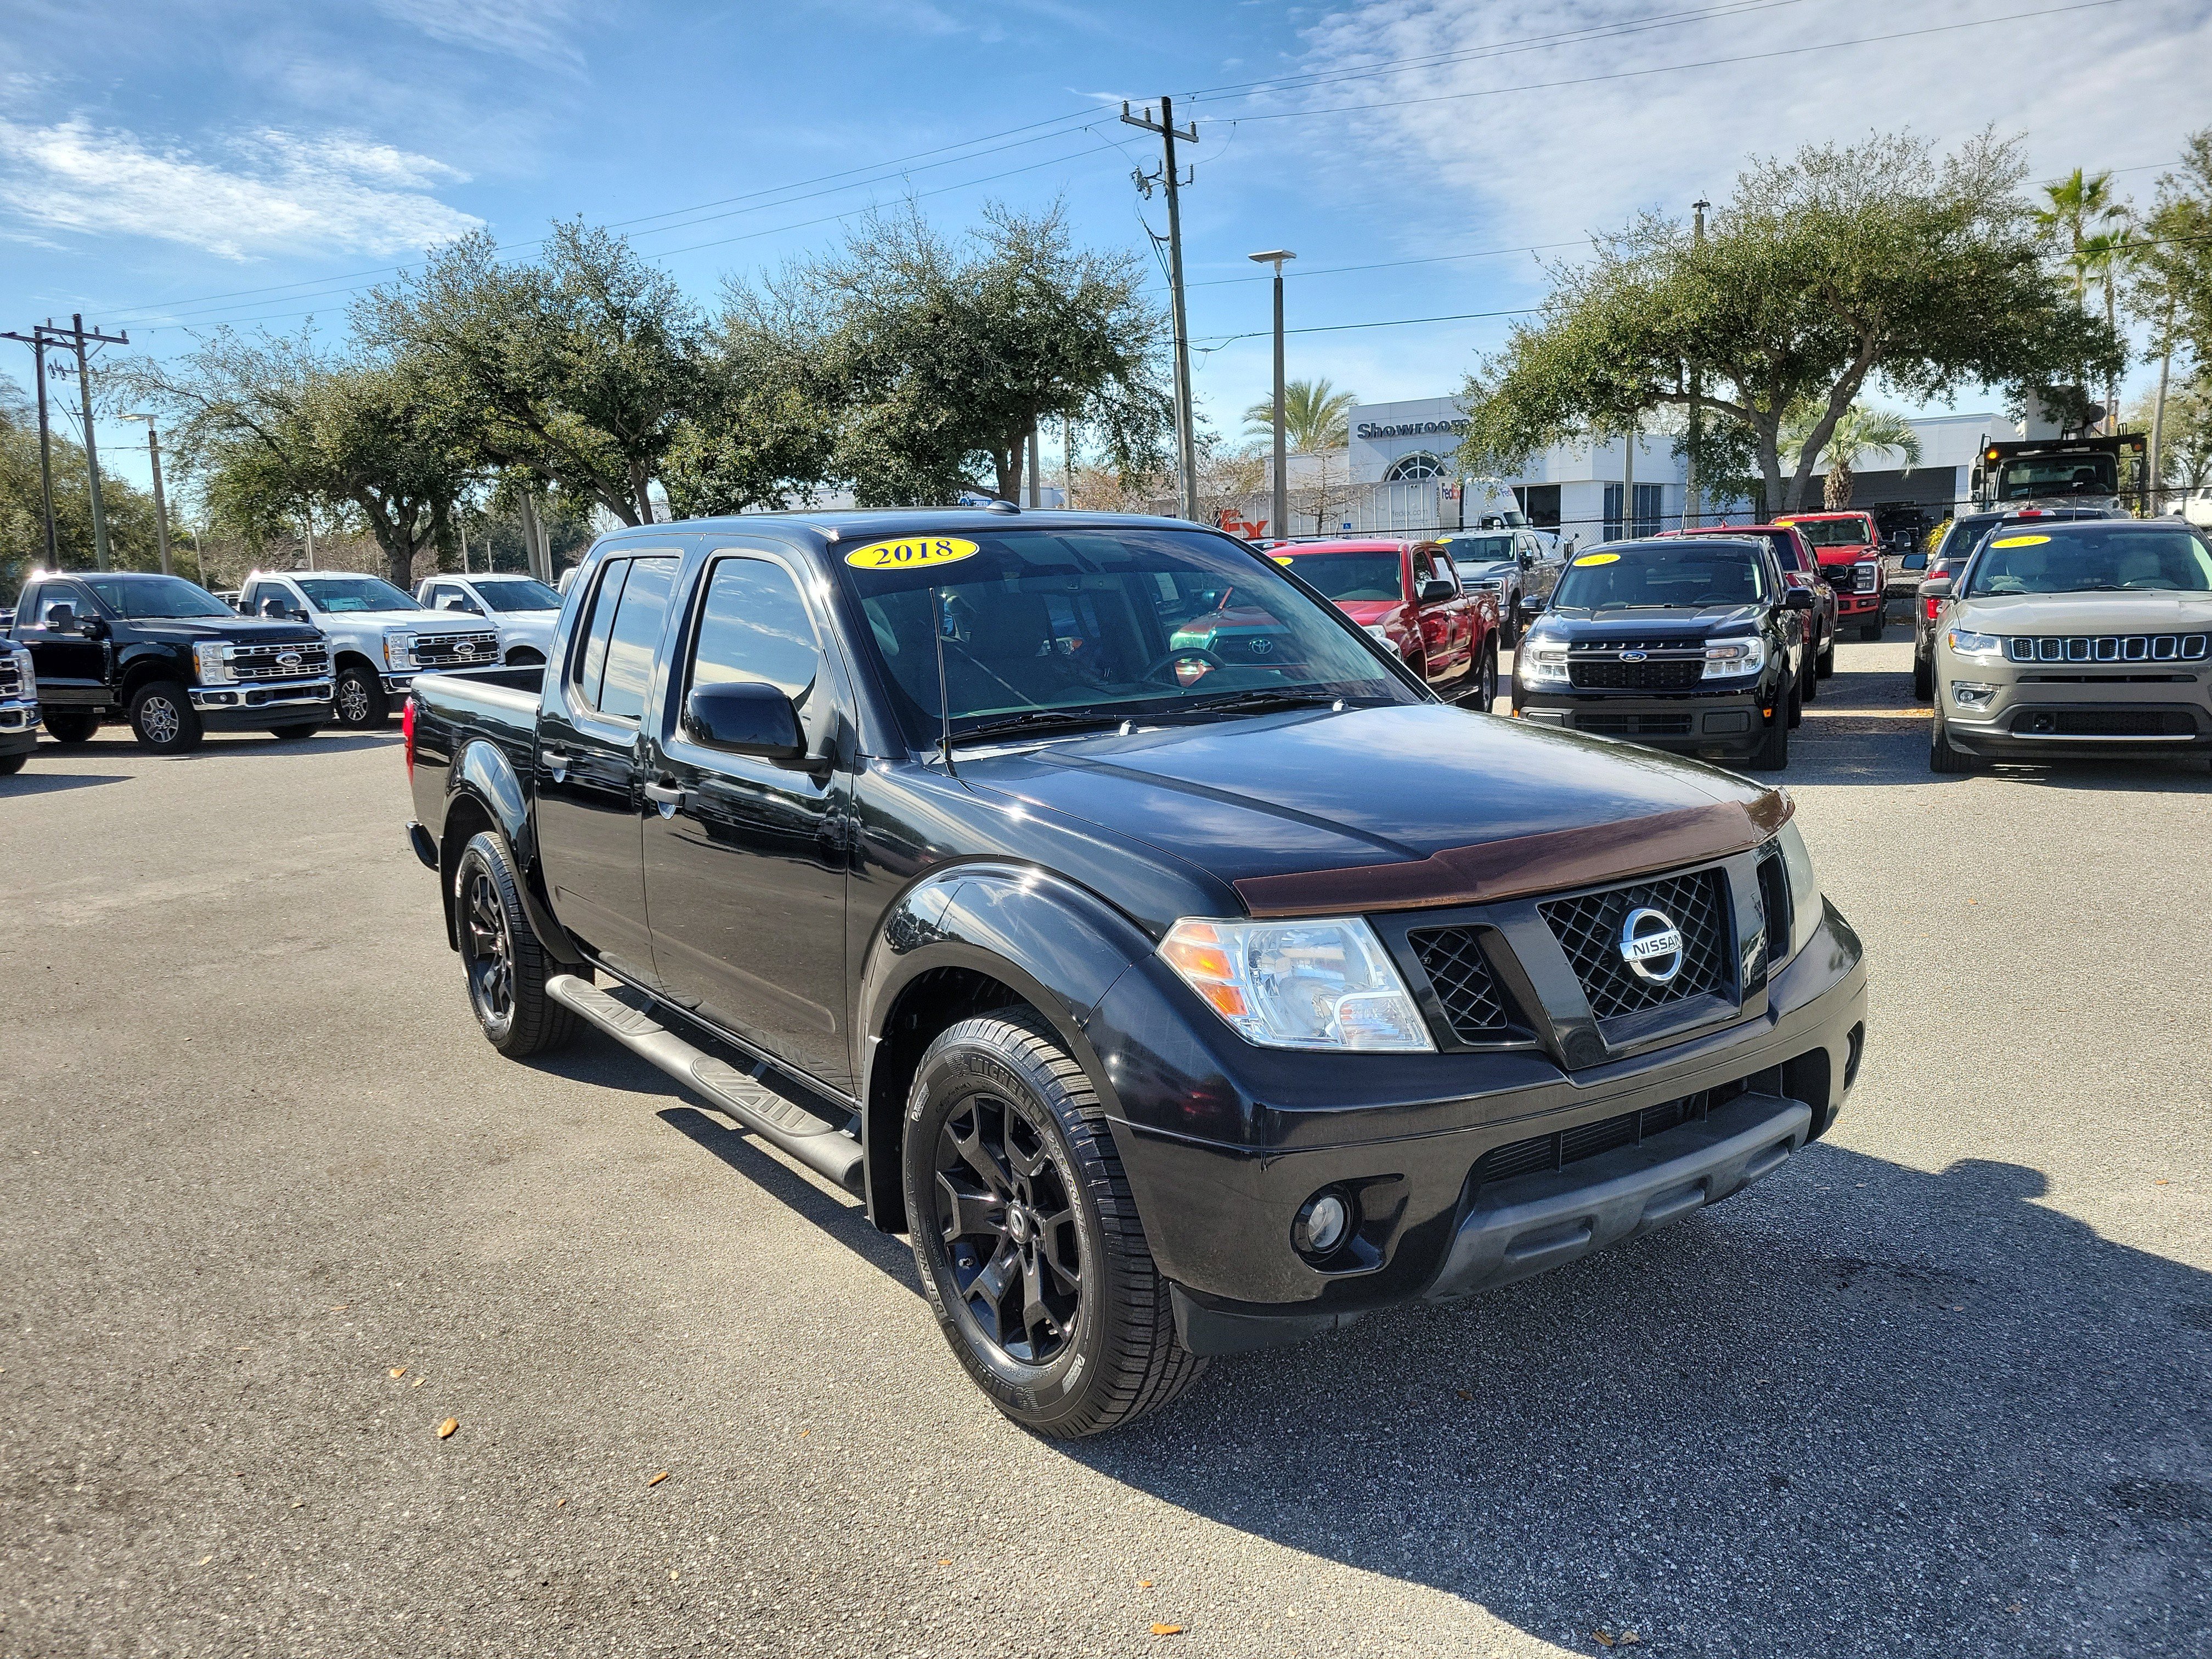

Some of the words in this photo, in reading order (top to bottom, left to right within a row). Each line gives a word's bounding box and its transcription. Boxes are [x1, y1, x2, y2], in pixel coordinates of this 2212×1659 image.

[1357, 419, 1470, 439] Showroom
[872, 540, 953, 566] 2018
[1632, 933, 1683, 956] NISSAN
[970, 1057, 1043, 1122] MICHELIN
[913, 1226, 945, 1314] DEFENDER
